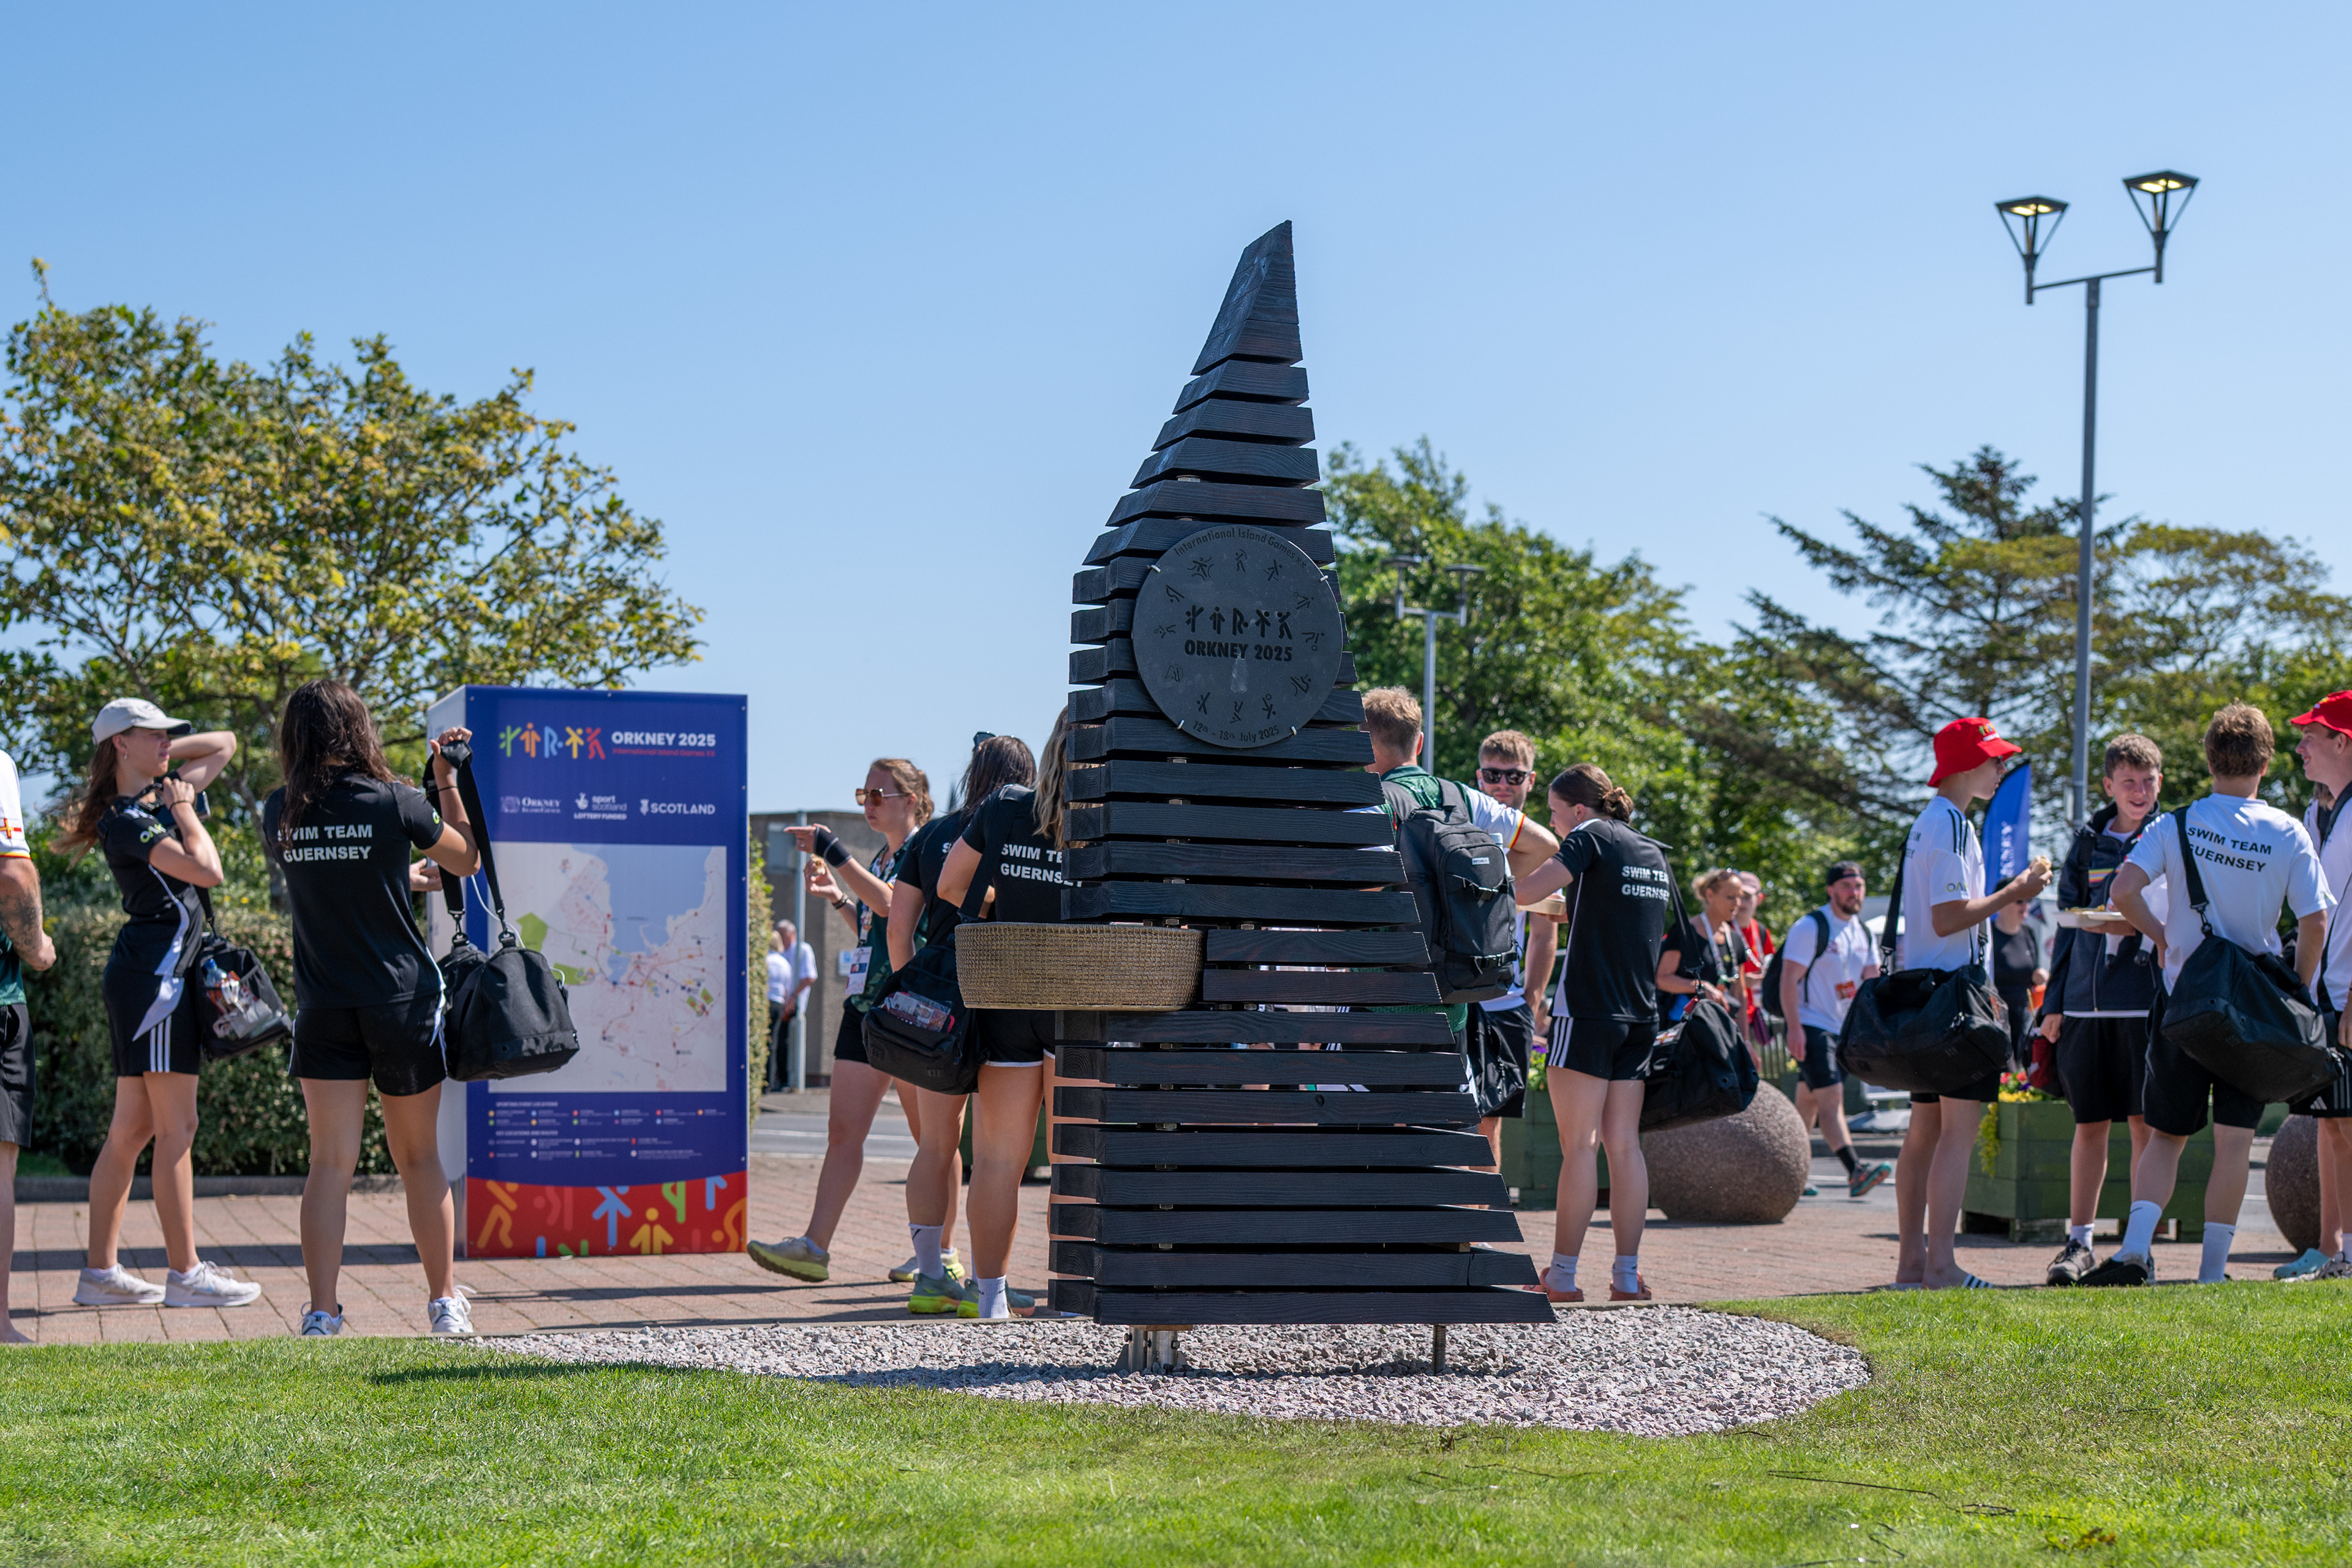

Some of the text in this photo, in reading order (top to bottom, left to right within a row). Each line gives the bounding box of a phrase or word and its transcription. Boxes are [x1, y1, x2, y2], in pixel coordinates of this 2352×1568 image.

[1174, 527, 1235, 557] International
[1238, 528, 1267, 543] Island
[1268, 537, 1295, 559] Games
[1184, 639, 1292, 662] ORKNEY 2025
[611, 731, 717, 747] ORKNEY 2025
[1193, 720, 1209, 733] 12th
[1219, 729, 1235, 741] 18th
[1239, 731, 1257, 744] July
[1258, 725, 1280, 740] 2025
[592, 794, 616, 804] sport
[592, 803, 628, 812] scotland
[650, 802, 716, 815] SCOTLAND
[324, 824, 373, 839] TEAM
[2187, 827, 2272, 855] SWIM TEAM
[283, 845, 372, 863] GUERNSEY
[1001, 843, 1041, 861] SWIM
[1621, 865, 1670, 885] SWIM TEA
[1621, 883, 1670, 902] GUERNSE
